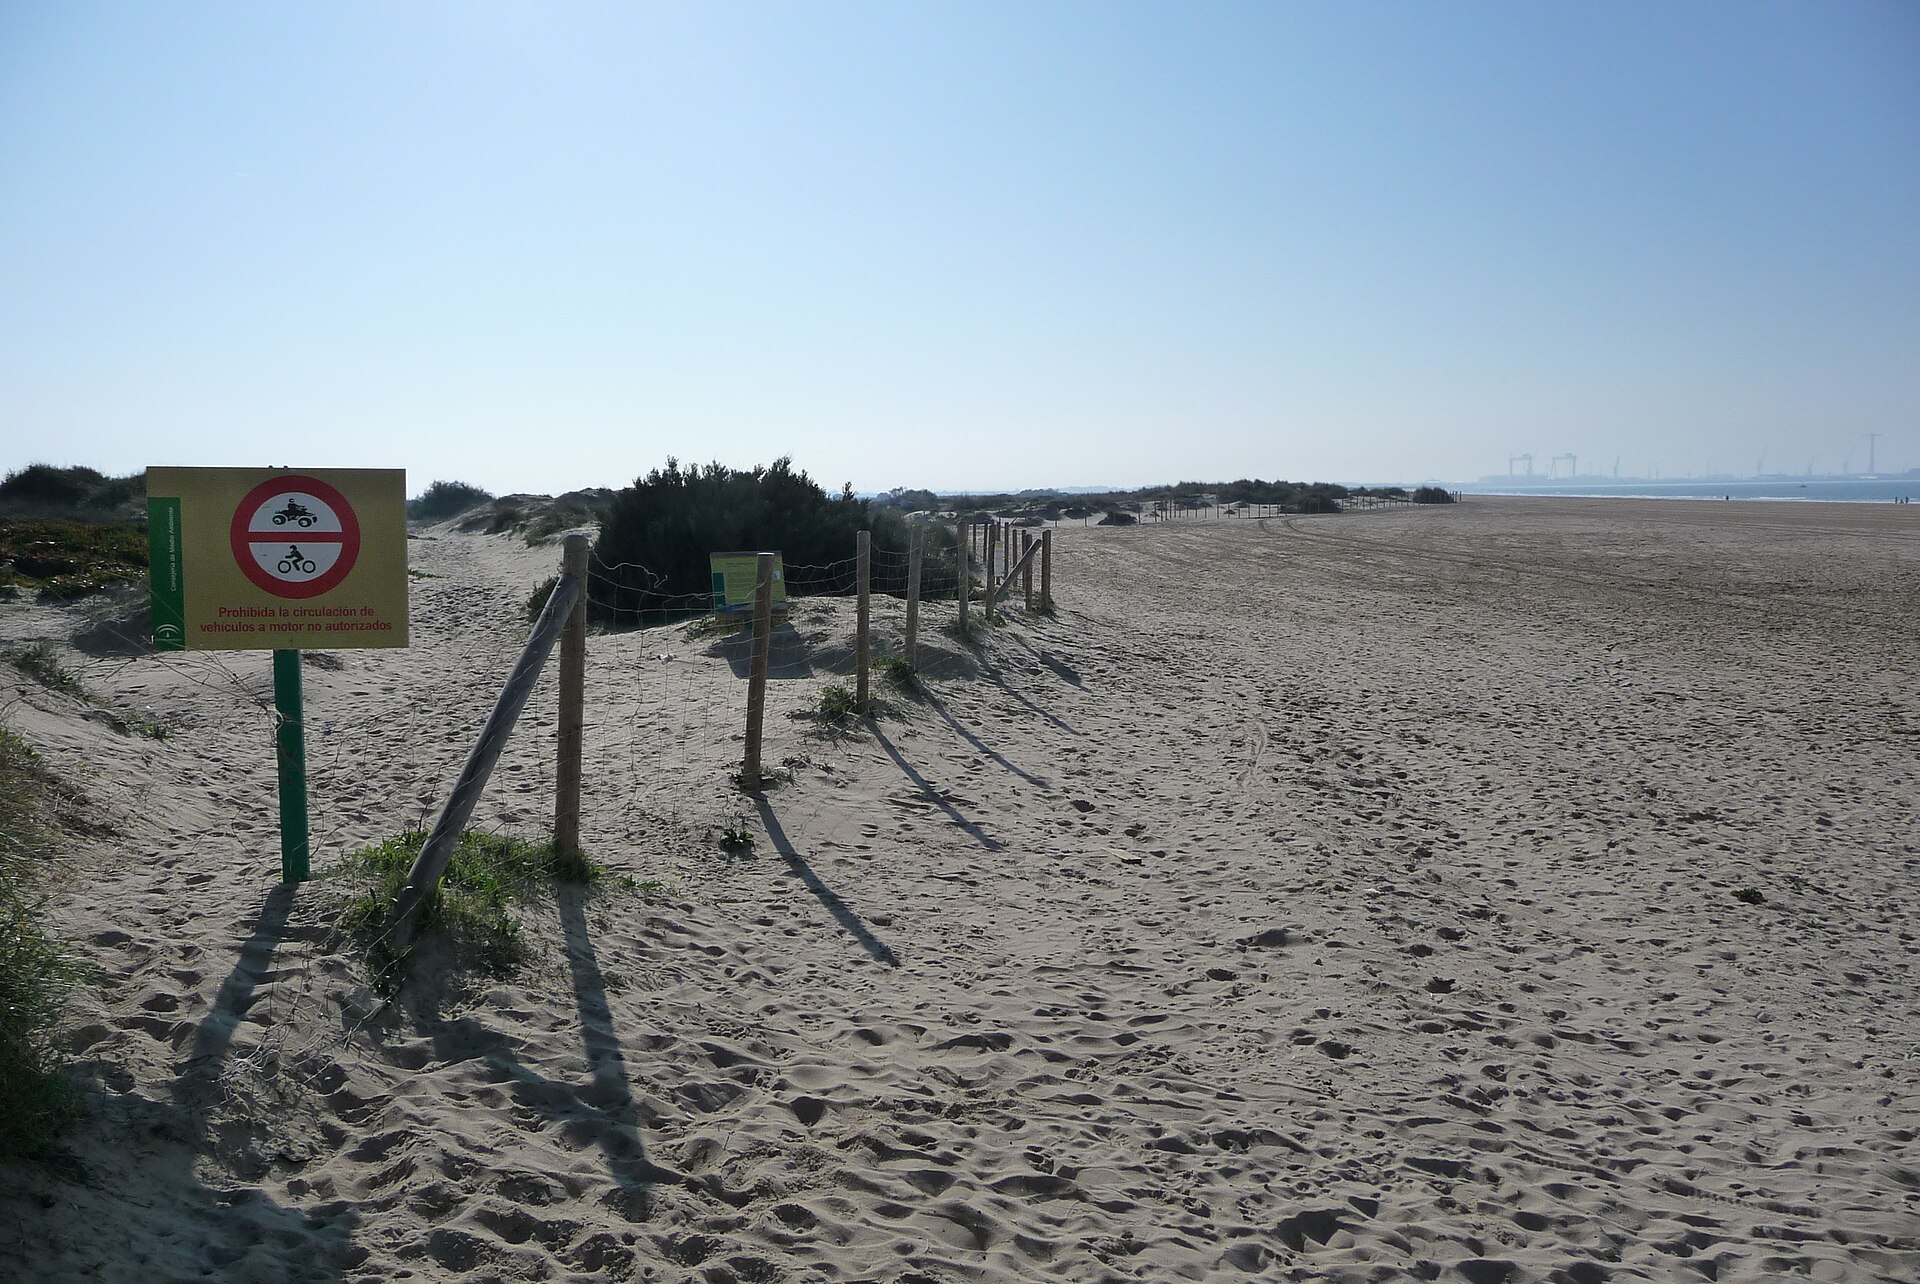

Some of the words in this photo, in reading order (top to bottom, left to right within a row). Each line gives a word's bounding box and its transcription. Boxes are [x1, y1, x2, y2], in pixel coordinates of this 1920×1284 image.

[218, 606, 276, 618] Prohibida
[279, 606, 290, 617] la
[293, 606, 356, 617] circulación
[360, 606, 374, 617] de
[200, 621, 255, 633] vehículos
[258, 623, 266, 632] a
[269, 622, 305, 632] motor
[307, 623, 322, 632] no
[325, 620, 392, 631] autorizados
